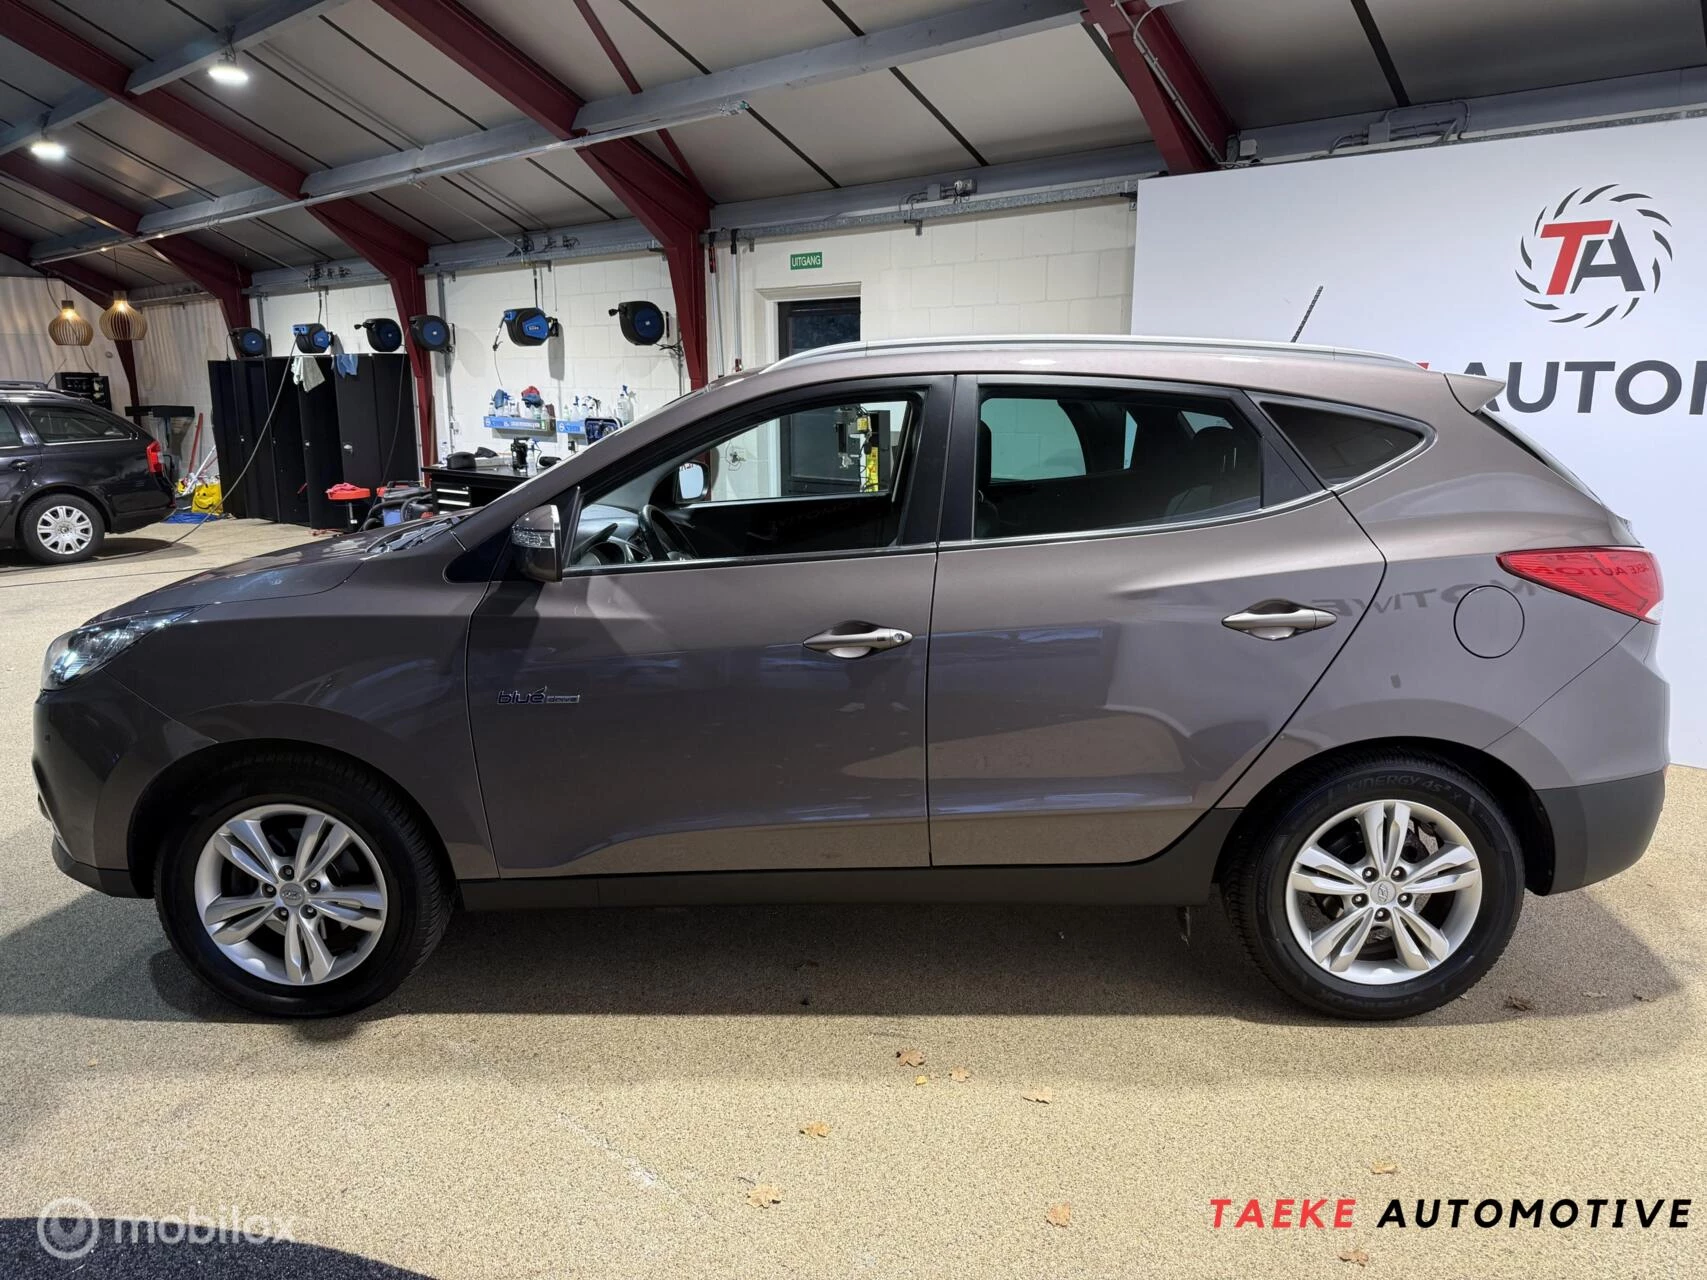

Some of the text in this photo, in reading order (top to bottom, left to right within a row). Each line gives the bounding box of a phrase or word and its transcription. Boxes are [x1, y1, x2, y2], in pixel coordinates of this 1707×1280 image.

[791, 254, 821, 267] UITGANG
[1540, 219, 1646, 295] TA
[1347, 775, 1420, 792] KINERGY
